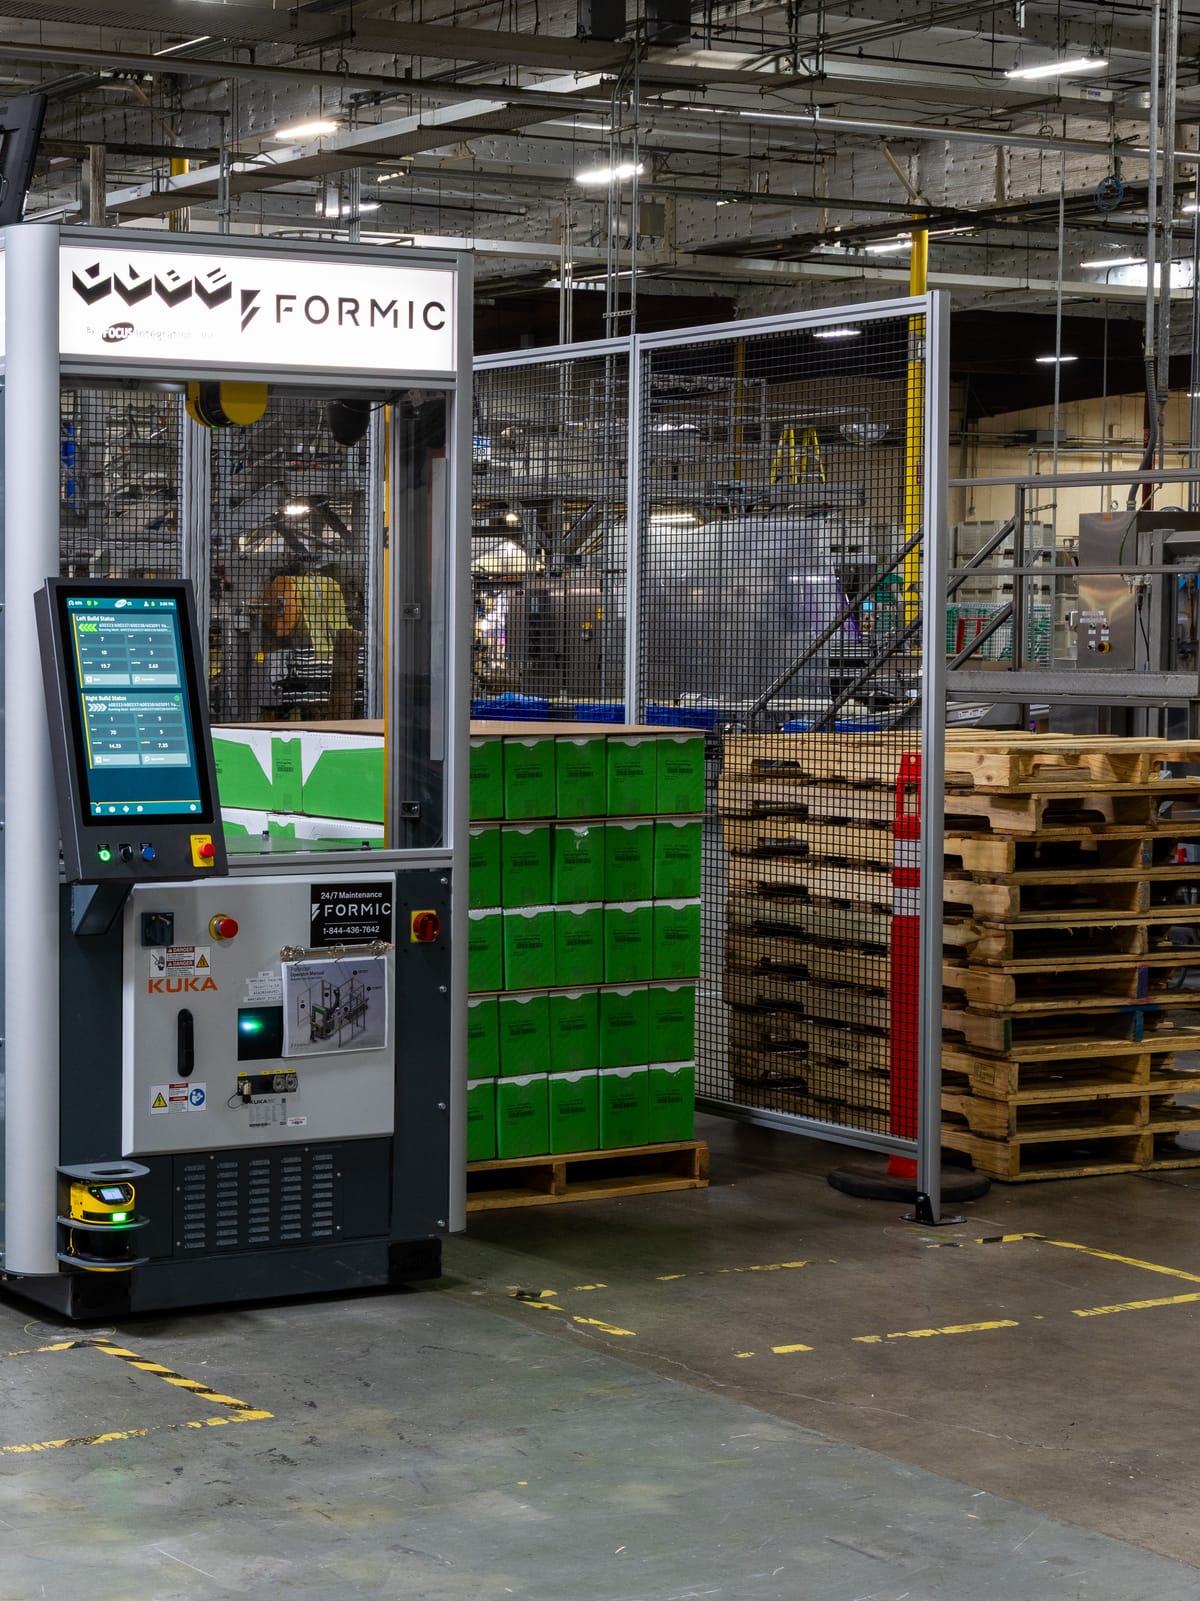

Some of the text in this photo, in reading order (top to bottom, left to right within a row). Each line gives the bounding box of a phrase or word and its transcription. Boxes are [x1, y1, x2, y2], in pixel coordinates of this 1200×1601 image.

[276, 294, 446, 331] FORMIC
[103, 327, 133, 339] FOCUS
[320, 891, 383, 900] 24/7 Maintenance
[324, 903, 391, 917] FORMIC
[323, 926, 380, 934] 1-844-436-7642
[148, 977, 218, 993] KUKA
